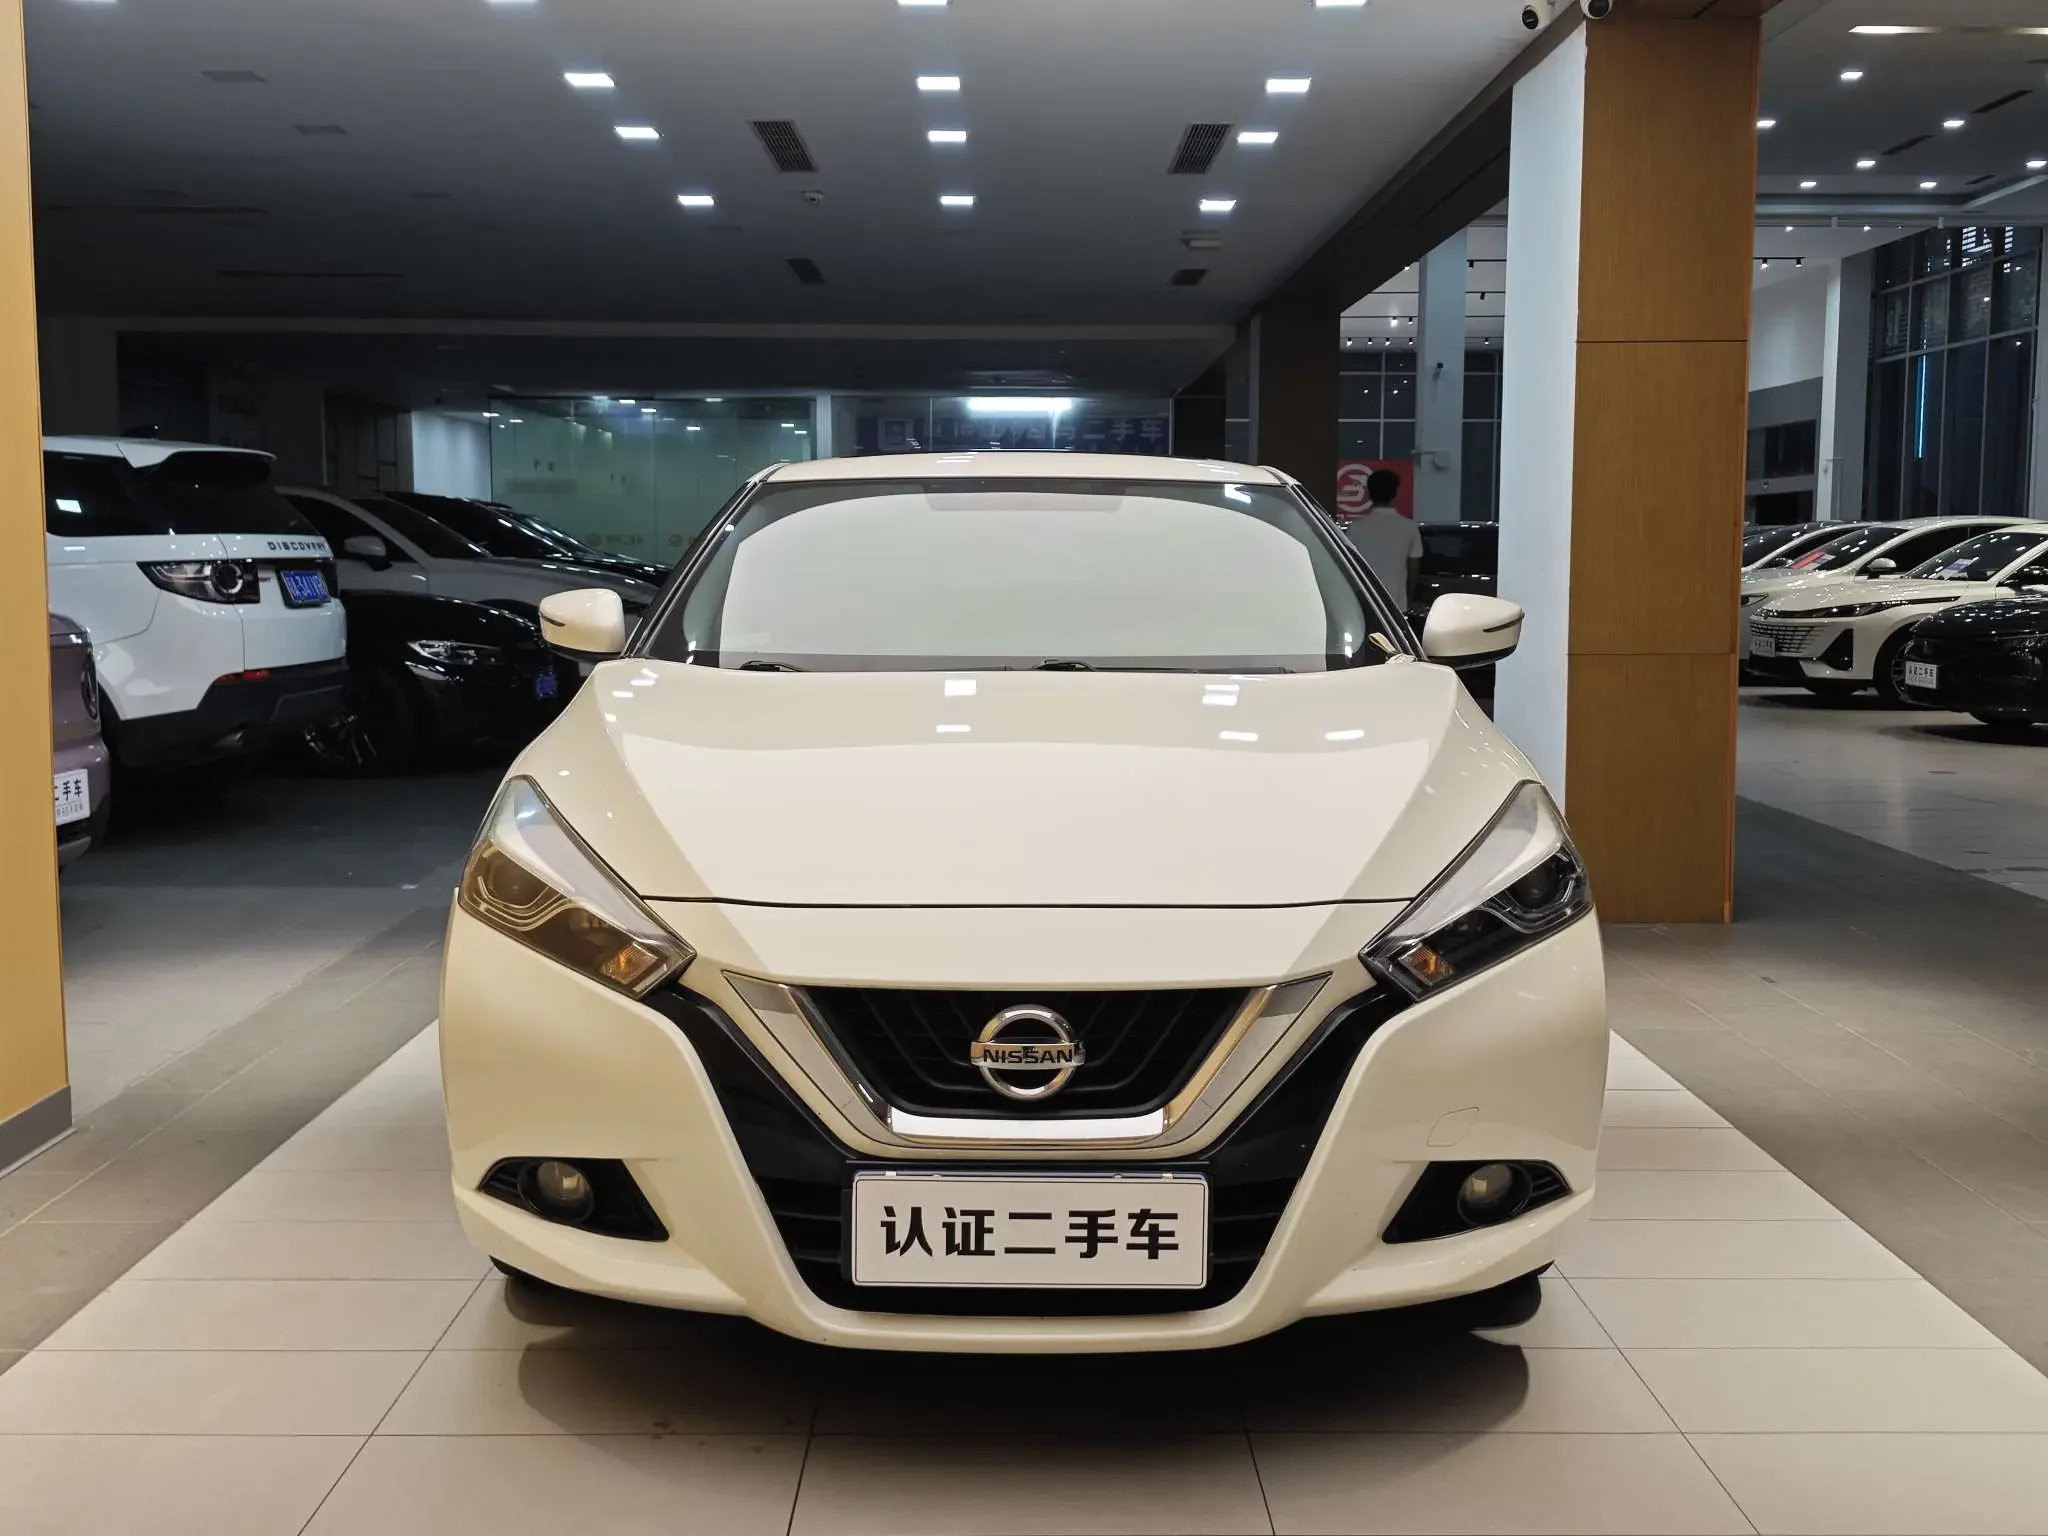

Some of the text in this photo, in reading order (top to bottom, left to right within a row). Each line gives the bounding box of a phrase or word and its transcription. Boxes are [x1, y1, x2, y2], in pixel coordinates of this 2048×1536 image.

[267, 541, 327, 553] DISCOVERY
[983, 1048, 1072, 1063] NISSAN
[880, 1206, 1179, 1260] 认证二手车
